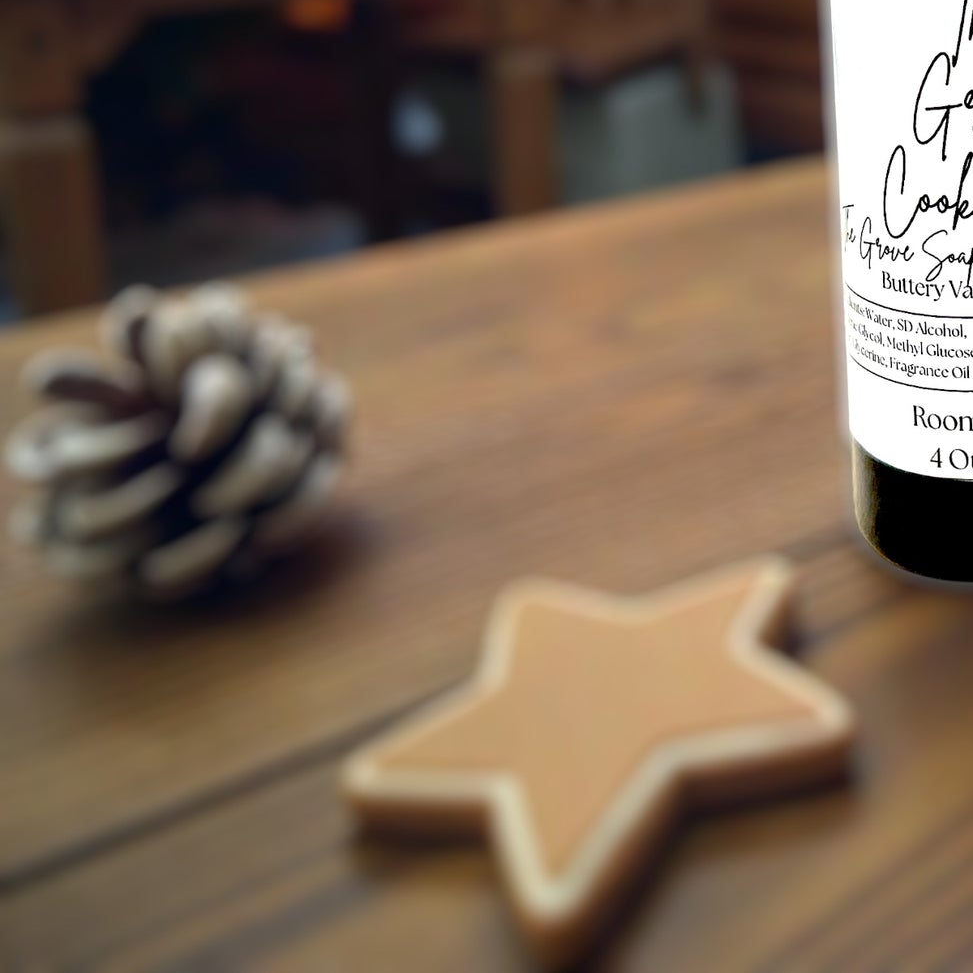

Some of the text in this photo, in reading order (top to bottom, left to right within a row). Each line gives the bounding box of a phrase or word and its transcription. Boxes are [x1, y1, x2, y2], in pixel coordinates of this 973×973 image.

[860, 216, 915, 269] Grove
[881, 270, 945, 301] Buttery
[897, 318, 913, 333] SD
[915, 321, 967, 339] Alcohol,
[886, 335, 923, 357] Methyl
[889, 356, 949, 378] Fragrance
[951, 365, 970, 379] Oil
[930, 447, 943, 468] 4
